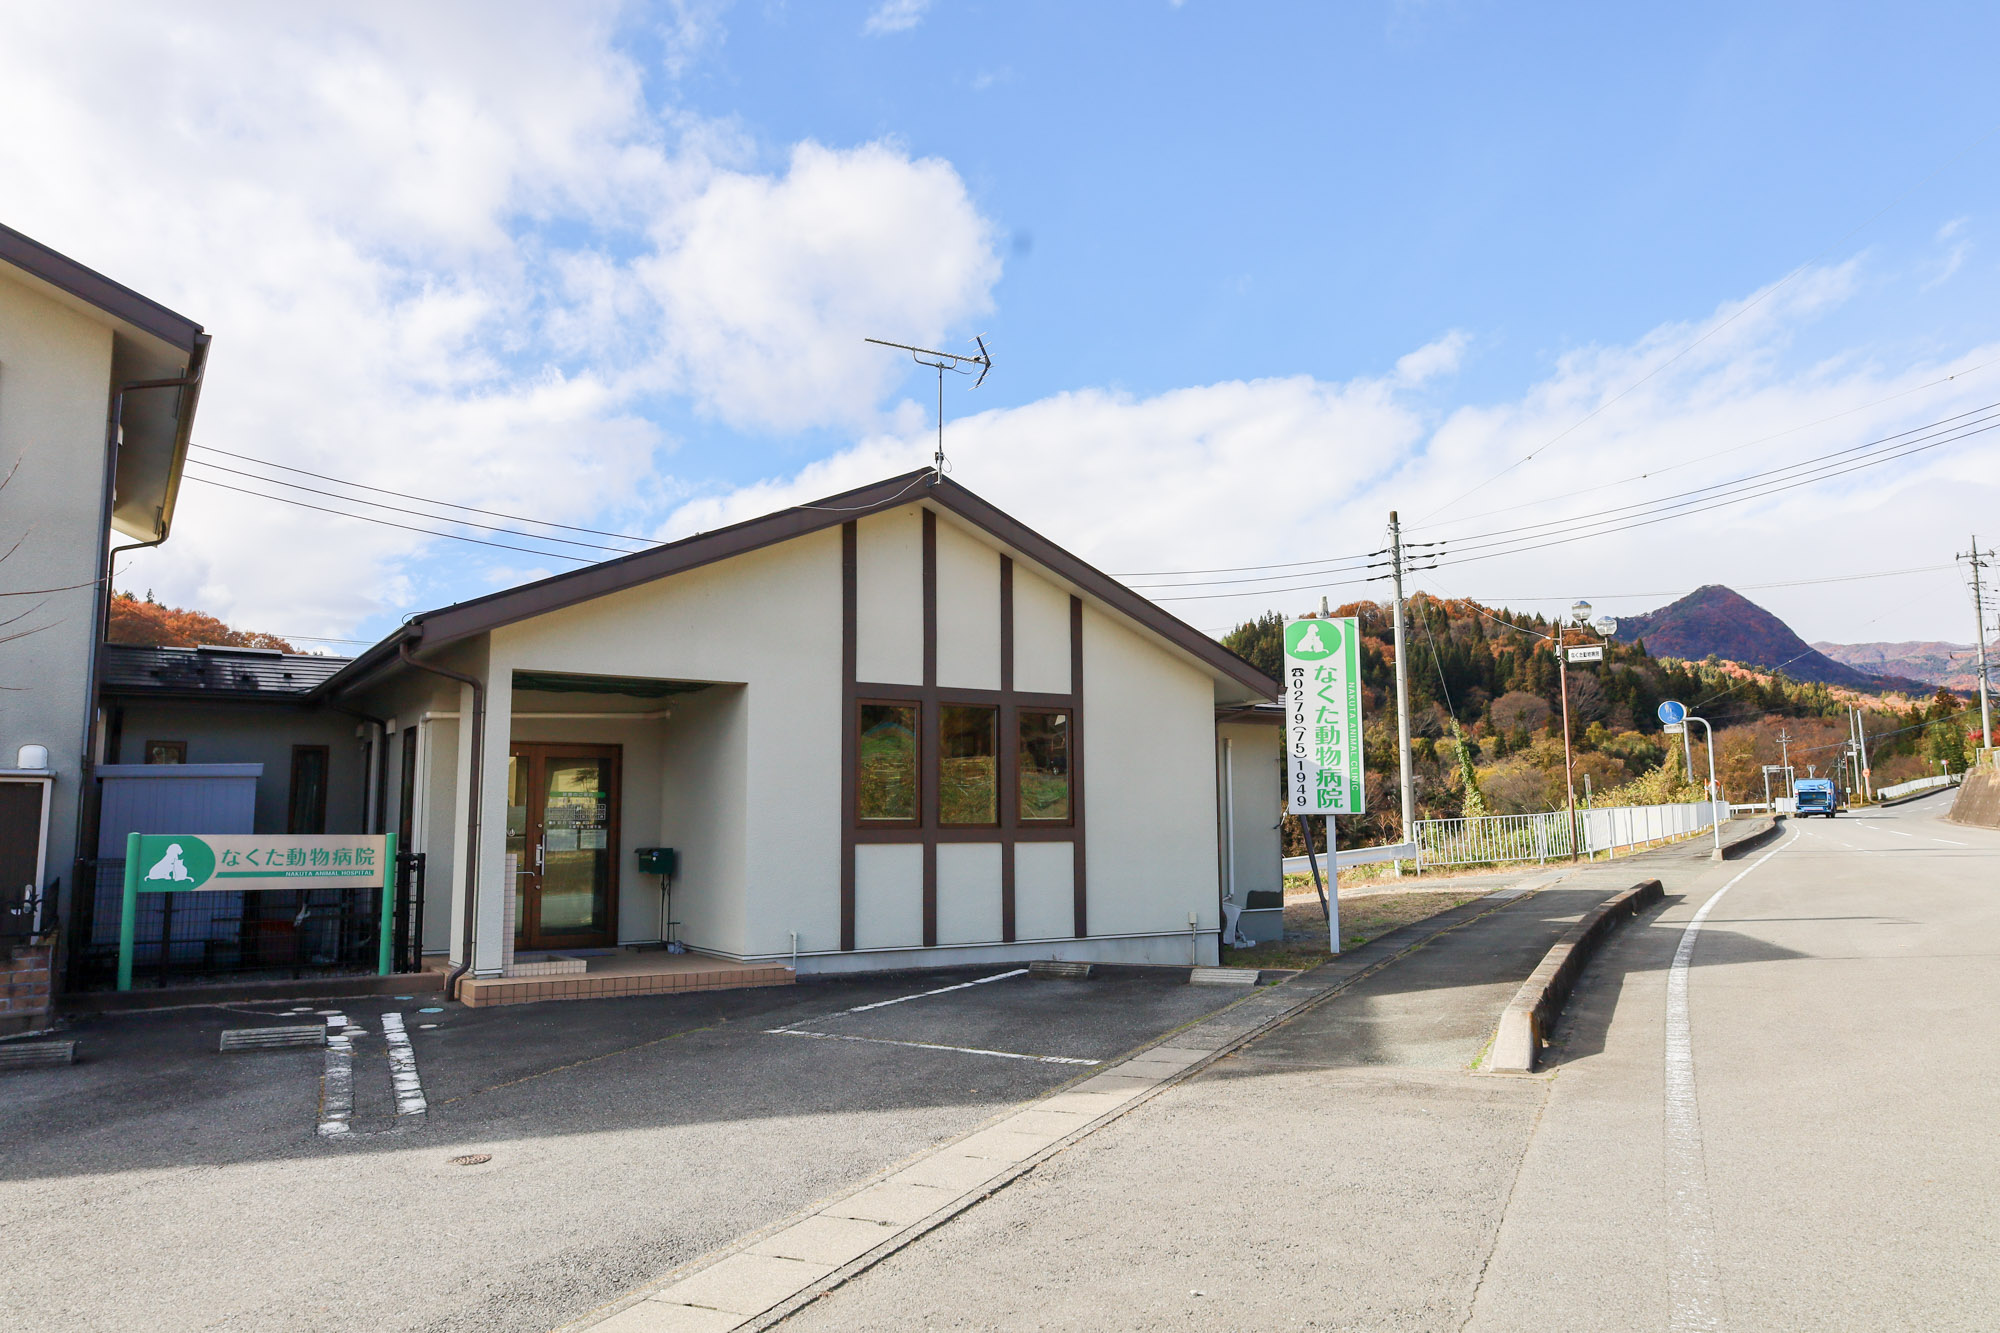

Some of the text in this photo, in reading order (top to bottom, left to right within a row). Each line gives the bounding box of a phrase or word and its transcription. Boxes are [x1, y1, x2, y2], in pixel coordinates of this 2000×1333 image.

[1314, 665, 1344, 809] なくた動物病院
[1348, 682, 1359, 791] NAKUTA ANIMAL CLINIC
[221, 847, 375, 867] なくた動物病院
